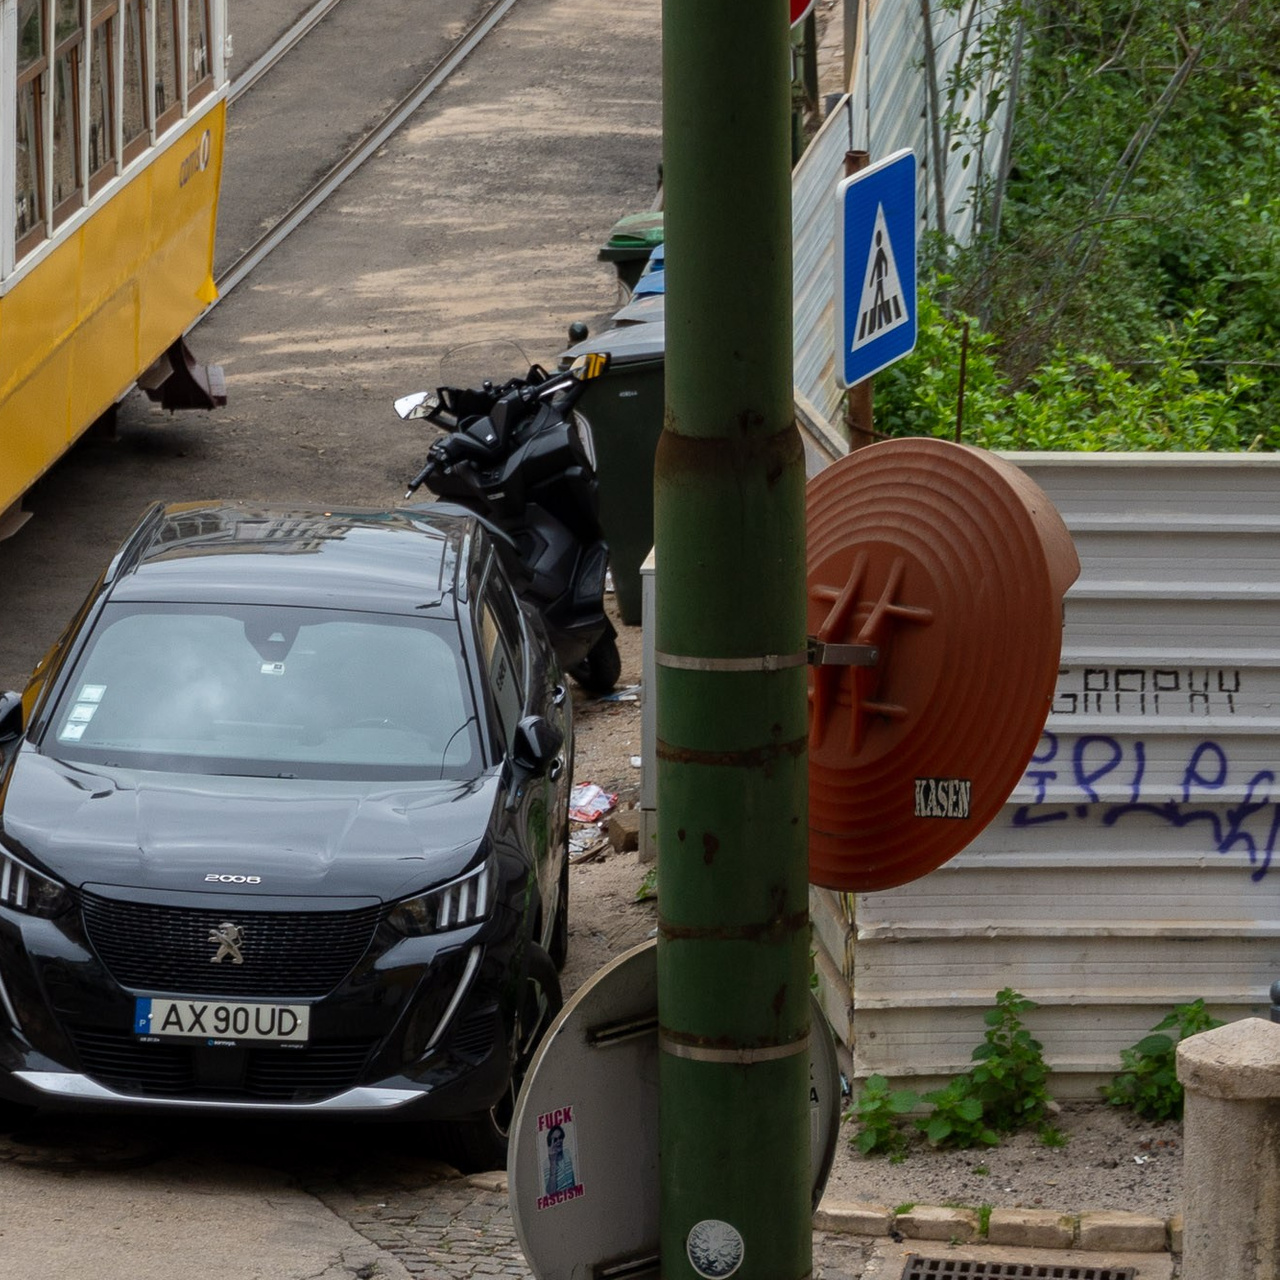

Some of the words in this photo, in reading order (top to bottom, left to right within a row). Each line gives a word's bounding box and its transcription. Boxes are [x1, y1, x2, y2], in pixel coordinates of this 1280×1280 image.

[914, 779, 970, 818] KASEN
[204, 873, 261, 884] 2008
[538, 1106, 572, 1132] FUCK
[537, 1183, 584, 1210] FASCISM
